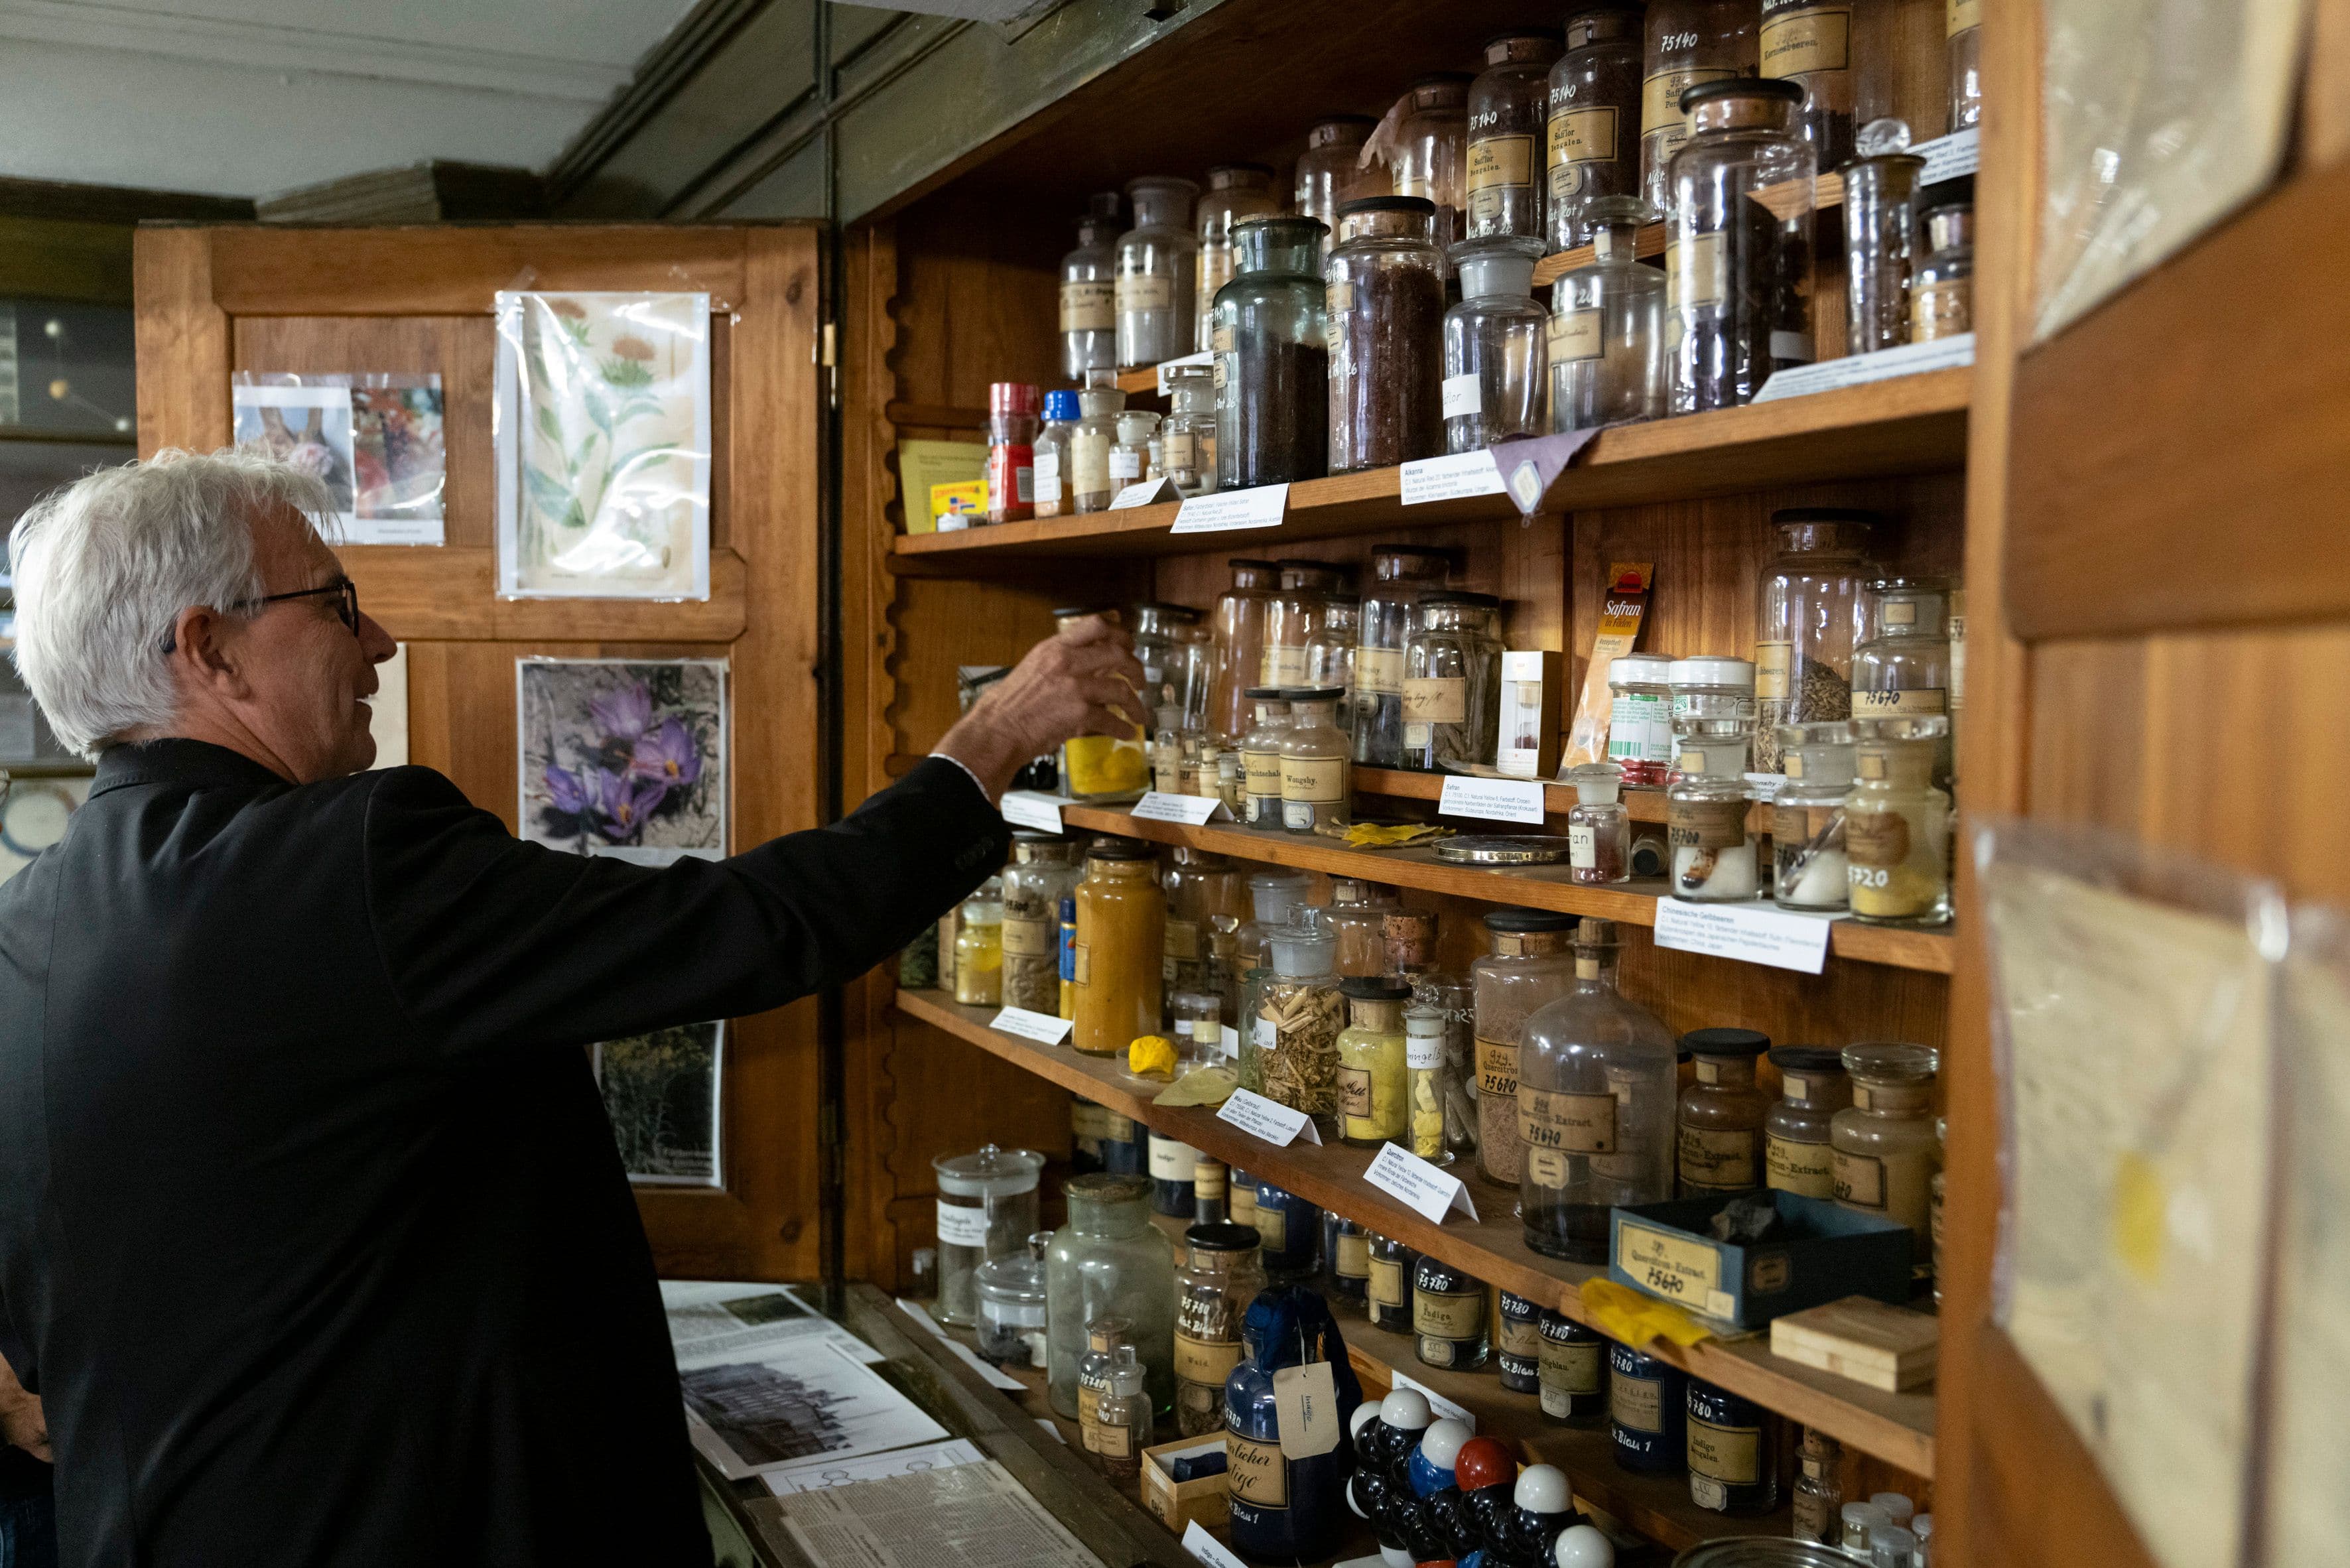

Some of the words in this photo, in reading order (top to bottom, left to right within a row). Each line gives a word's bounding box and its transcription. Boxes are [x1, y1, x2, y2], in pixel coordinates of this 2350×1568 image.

[1661, 32, 1698, 52] 75140
[1665, 87, 1685, 99] Saffl
[1604, 600, 1641, 619] Safran
[1866, 690, 1900, 706] 75670
[1287, 775, 1318, 786] Wongshy.
[1847, 866, 1888, 887] 5720
[1662, 905, 1698, 919] Chinesische
[1484, 1074, 1518, 1094] 75670
[1529, 1124, 1561, 1147] 75670
[1418, 1273, 1449, 1291] 75780
[1647, 1266, 1684, 1293] 75670
[1181, 1295, 1210, 1315] 75780
[1502, 1295, 1530, 1315] 75780
[1540, 1318, 1569, 1340] 75780
[1687, 1396, 1712, 1418] 5780
[1226, 1407, 1242, 1428] 5780
[1618, 1430, 1640, 1451] Blau
[1645, 1440, 1652, 1453] 1
[1692, 1435, 1716, 1452] Indigo
[1253, 1513, 1260, 1524] 1
[1201, 1546, 1212, 1559] Indigo
